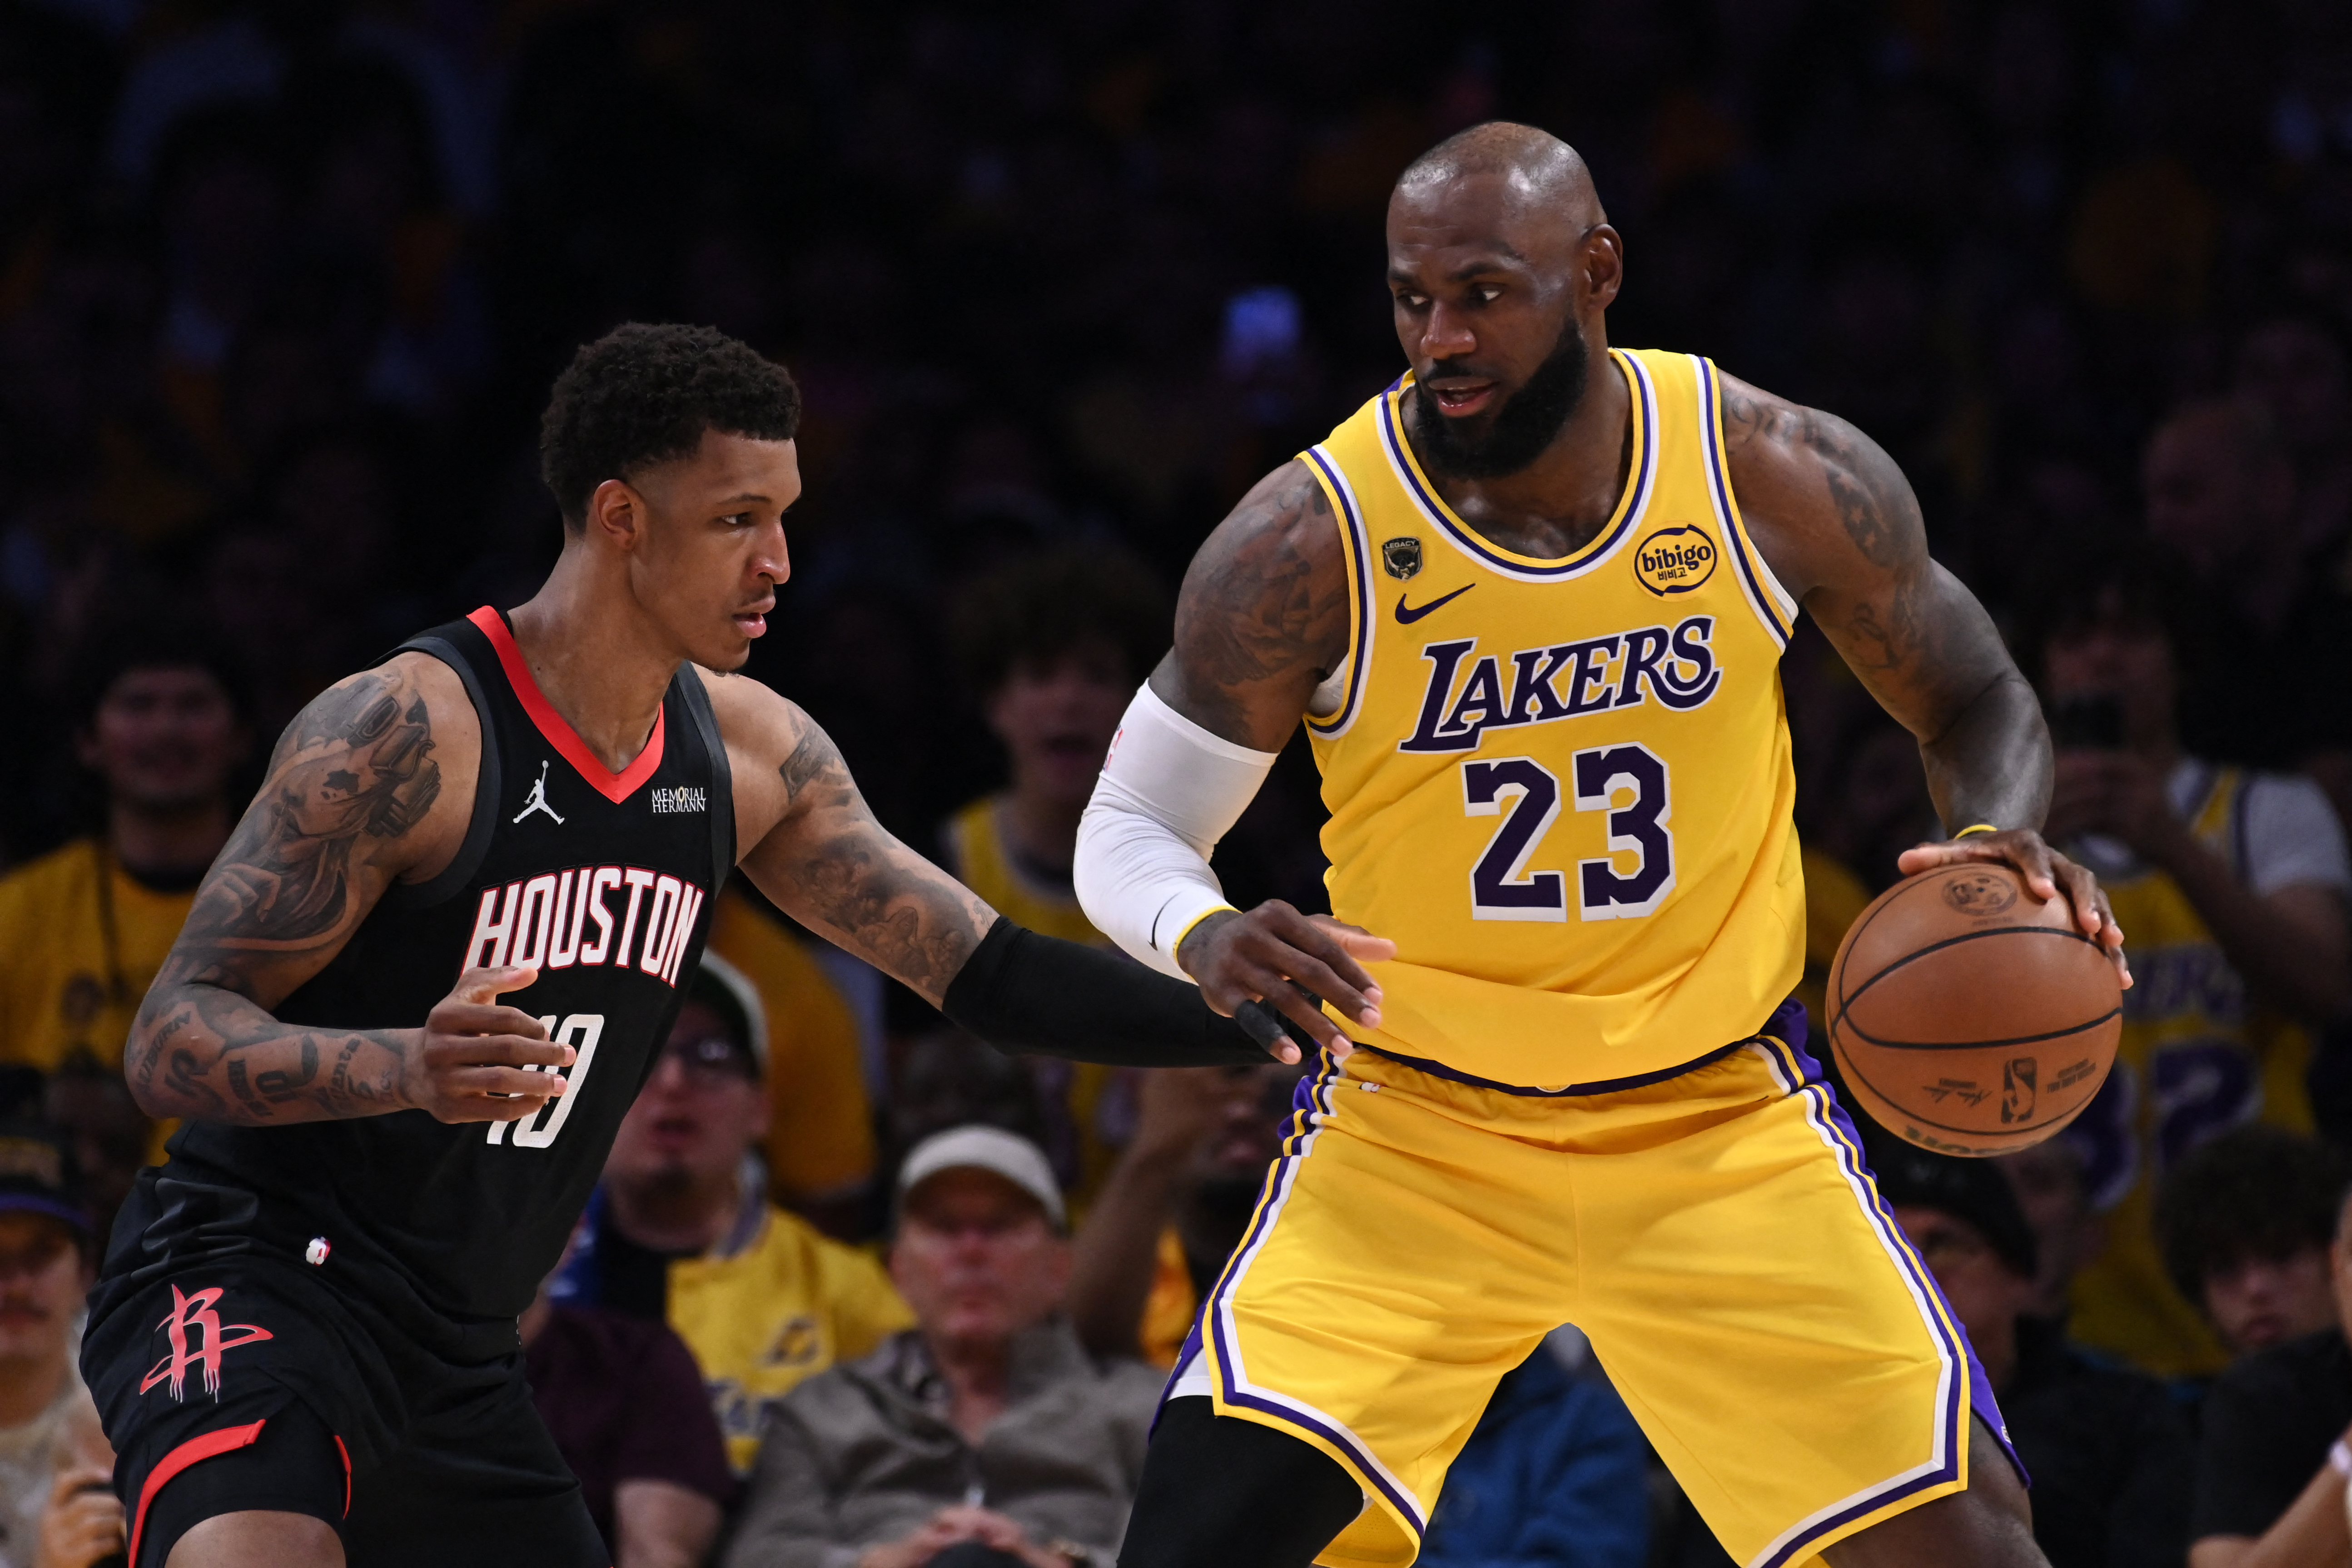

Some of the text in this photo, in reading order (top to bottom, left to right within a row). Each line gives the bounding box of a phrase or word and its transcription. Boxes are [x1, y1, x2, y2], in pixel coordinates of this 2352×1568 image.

[1385, 540, 1416, 549] LEGACY
[1641, 545, 1711, 572] bibigo
[1657, 567, 1687, 581] 비비고
[1397, 614, 1724, 754] LAKERS
[652, 786, 706, 802] MEMORIAL
[652, 799, 705, 813] HERMANN
[1460, 741, 1676, 922] 23
[460, 863, 704, 987] HOUSTON
